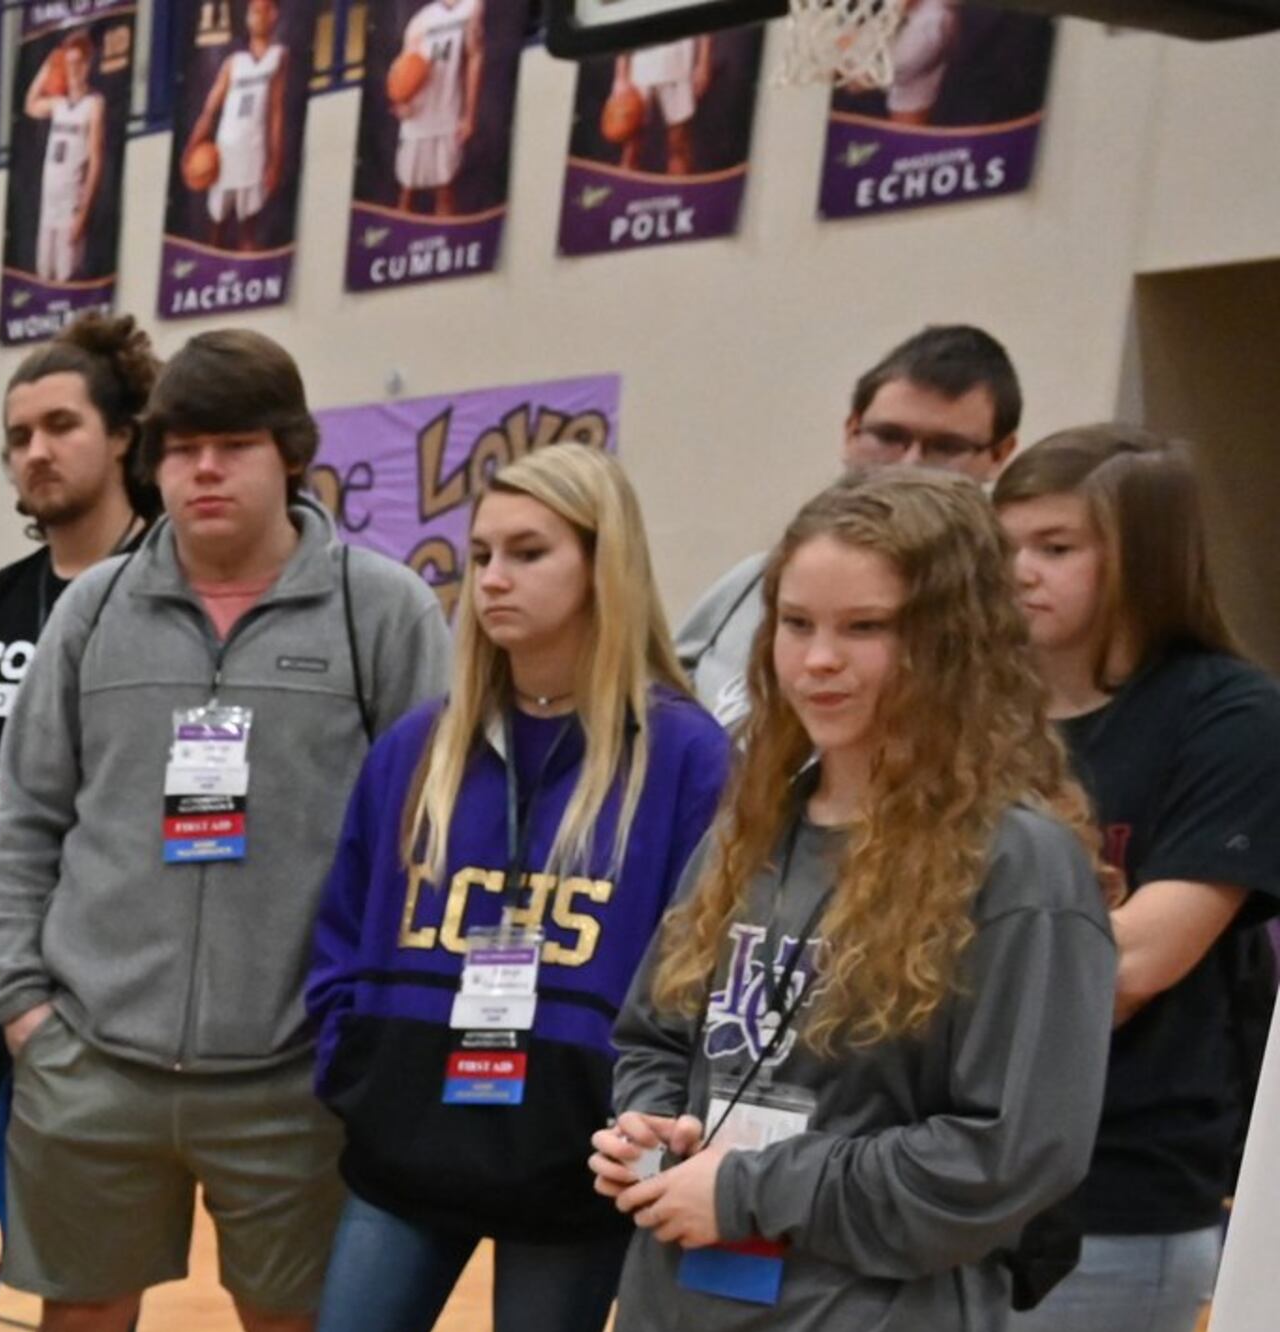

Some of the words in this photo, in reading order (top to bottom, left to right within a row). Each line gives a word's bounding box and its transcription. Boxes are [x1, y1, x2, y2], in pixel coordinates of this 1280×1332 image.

[856, 155, 1006, 208] ECHOLS
[609, 206, 695, 244] POLK
[369, 241, 482, 284] CUMBIE
[171, 276, 282, 313] JACKSON
